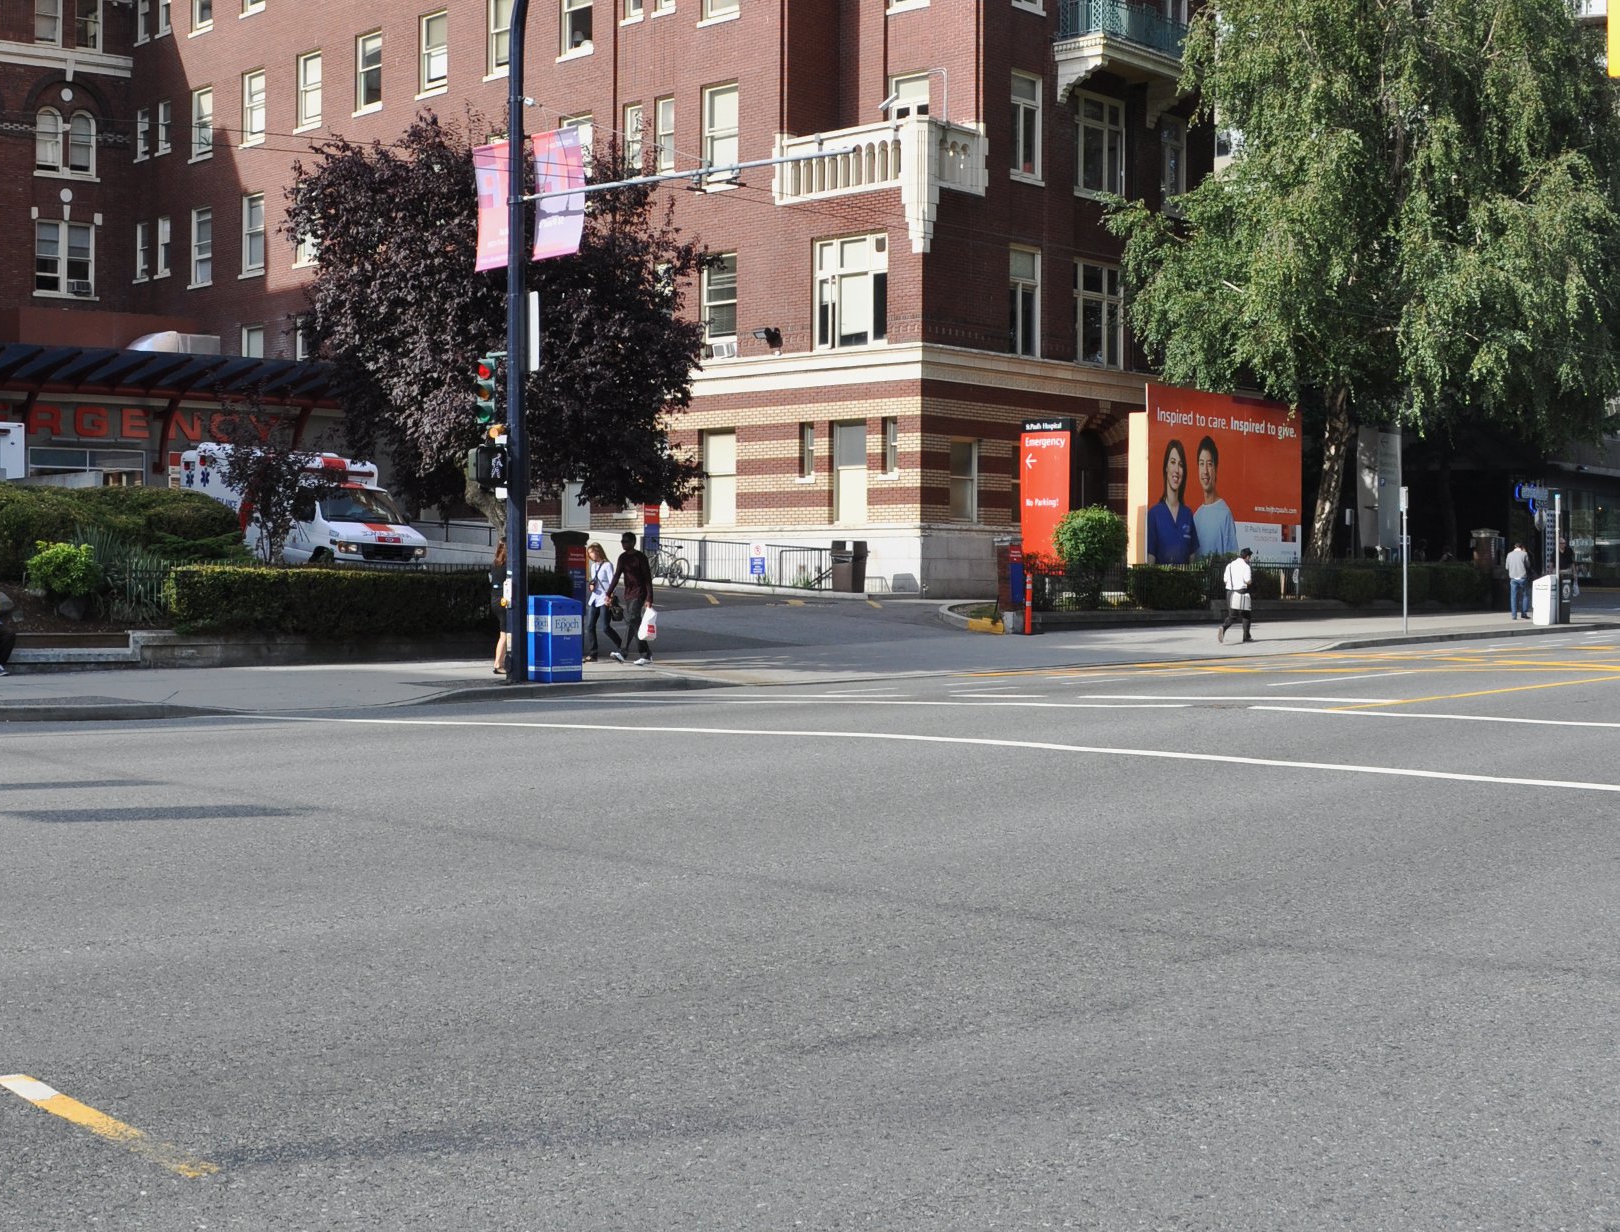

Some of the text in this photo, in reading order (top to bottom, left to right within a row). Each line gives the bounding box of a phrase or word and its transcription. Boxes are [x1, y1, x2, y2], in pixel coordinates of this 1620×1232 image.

[1157, 407, 1297, 440] Inspired to care. Inspired to give.
[1025, 436, 1065, 449] Emergency
[1025, 497, 1059, 508] No Parking!
[555, 618, 579, 632] Epoch
